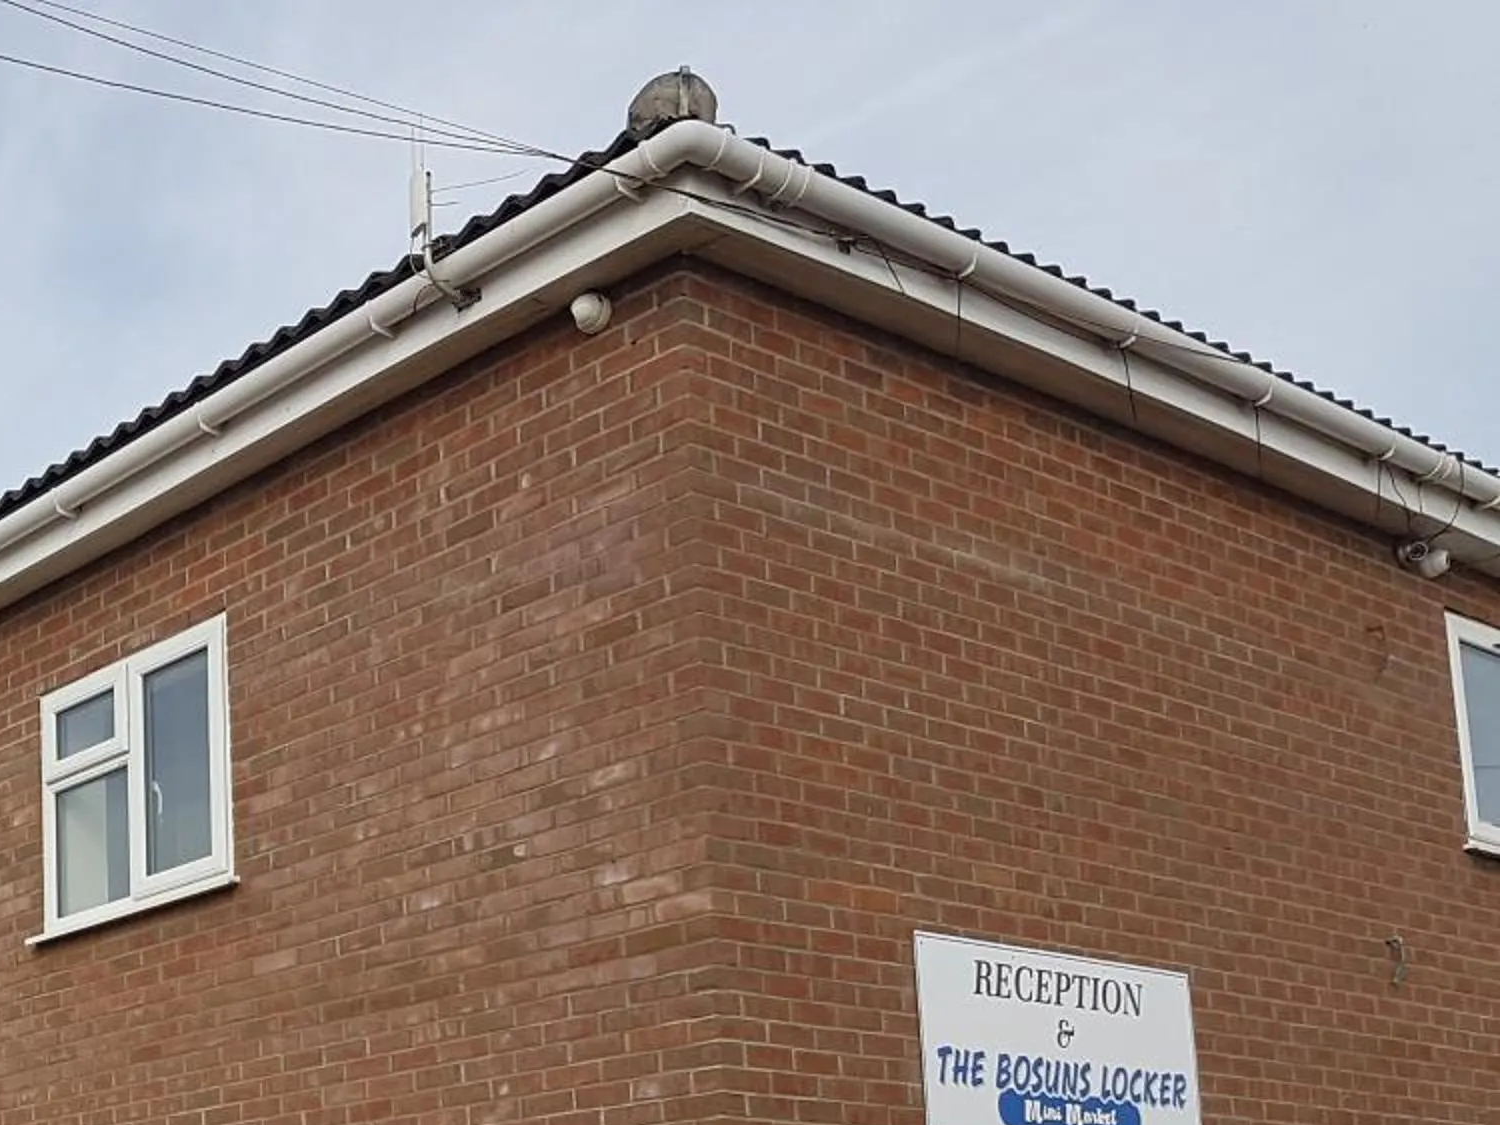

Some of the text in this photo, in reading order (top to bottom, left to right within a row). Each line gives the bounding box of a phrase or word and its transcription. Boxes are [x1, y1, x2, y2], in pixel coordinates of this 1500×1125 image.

[973, 959, 1142, 1016] RECEPTION
[1057, 1019, 1074, 1048] &
[937, 1046, 1186, 1108] THE BOSUNS LOCKER
[1025, 1099, 1062, 1124] Mini
